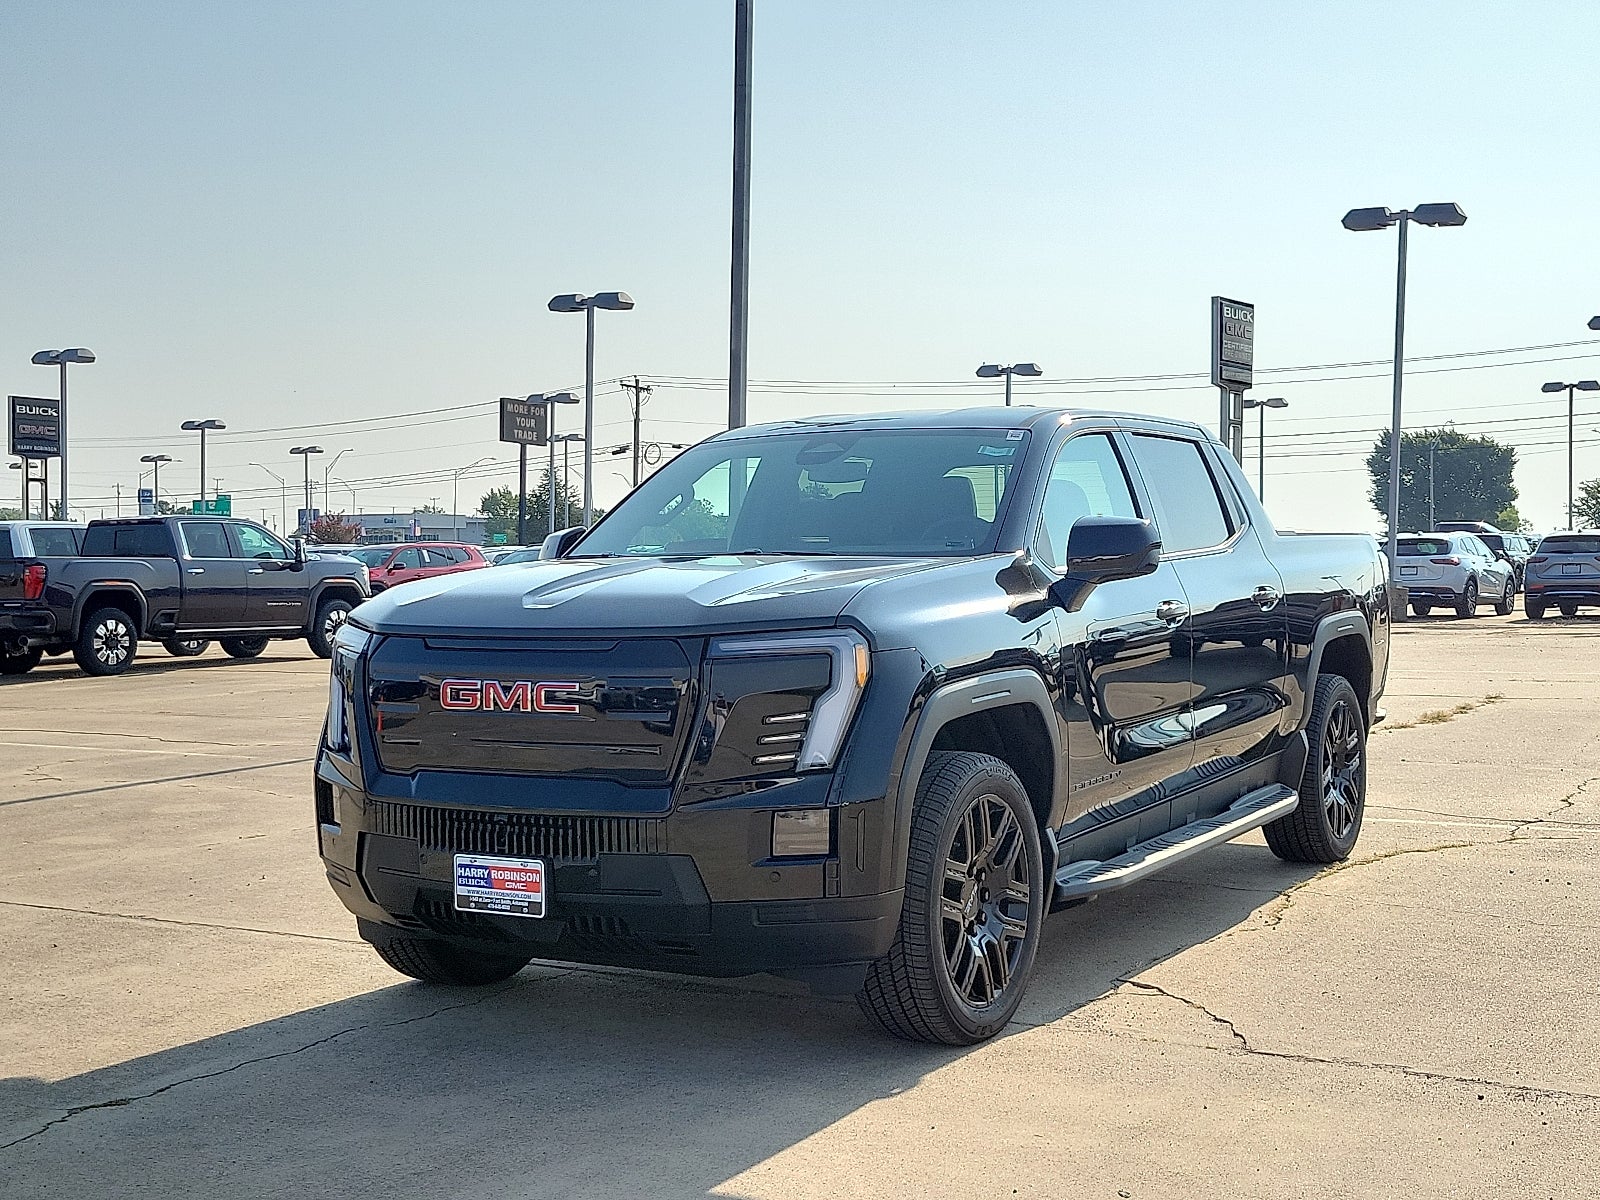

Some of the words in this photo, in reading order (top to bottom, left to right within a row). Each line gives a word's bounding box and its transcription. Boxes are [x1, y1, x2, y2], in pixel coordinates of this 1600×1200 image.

[1223, 306, 1254, 323] BUICK
[1225, 321, 1253, 340] GMC
[16, 404, 59, 416] BUICK
[506, 402, 529, 415] MORE
[530, 406, 545, 417] FOR
[516, 416, 536, 429] YOUR
[18, 424, 57, 436] GMC
[513, 428, 538, 441] TRADE
[440, 678, 580, 714] GMC
[458, 867, 490, 879] HARRY
[491, 869, 540, 883] ROBINSON
[458, 877, 489, 887] BUICK
[505, 881, 527, 890] GMC
